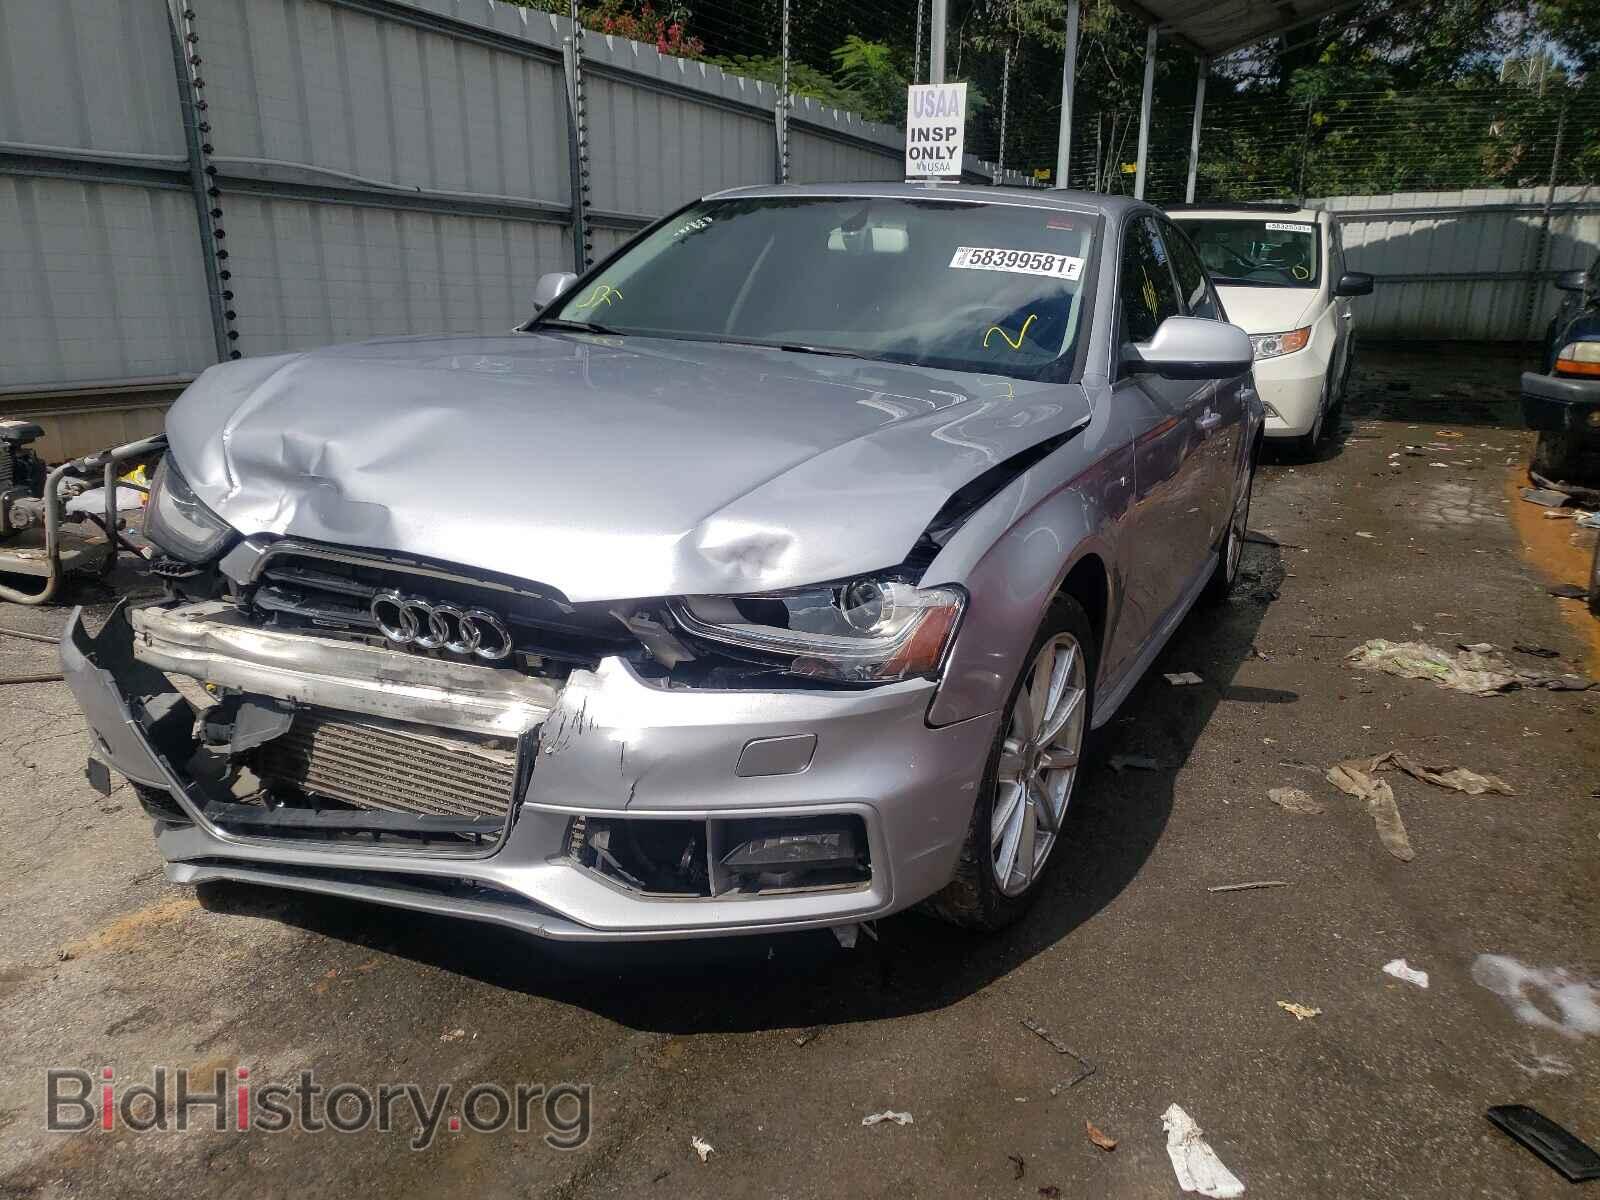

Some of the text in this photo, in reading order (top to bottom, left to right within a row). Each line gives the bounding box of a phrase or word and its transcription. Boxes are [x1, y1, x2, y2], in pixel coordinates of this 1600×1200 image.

[913, 89, 960, 118] USAA
[911, 126, 957, 142] INSP
[908, 145, 958, 160] ONLY
[927, 161, 951, 172] USAA
[969, 249, 1067, 273] 58399581
[1068, 263, 1077, 273] F
